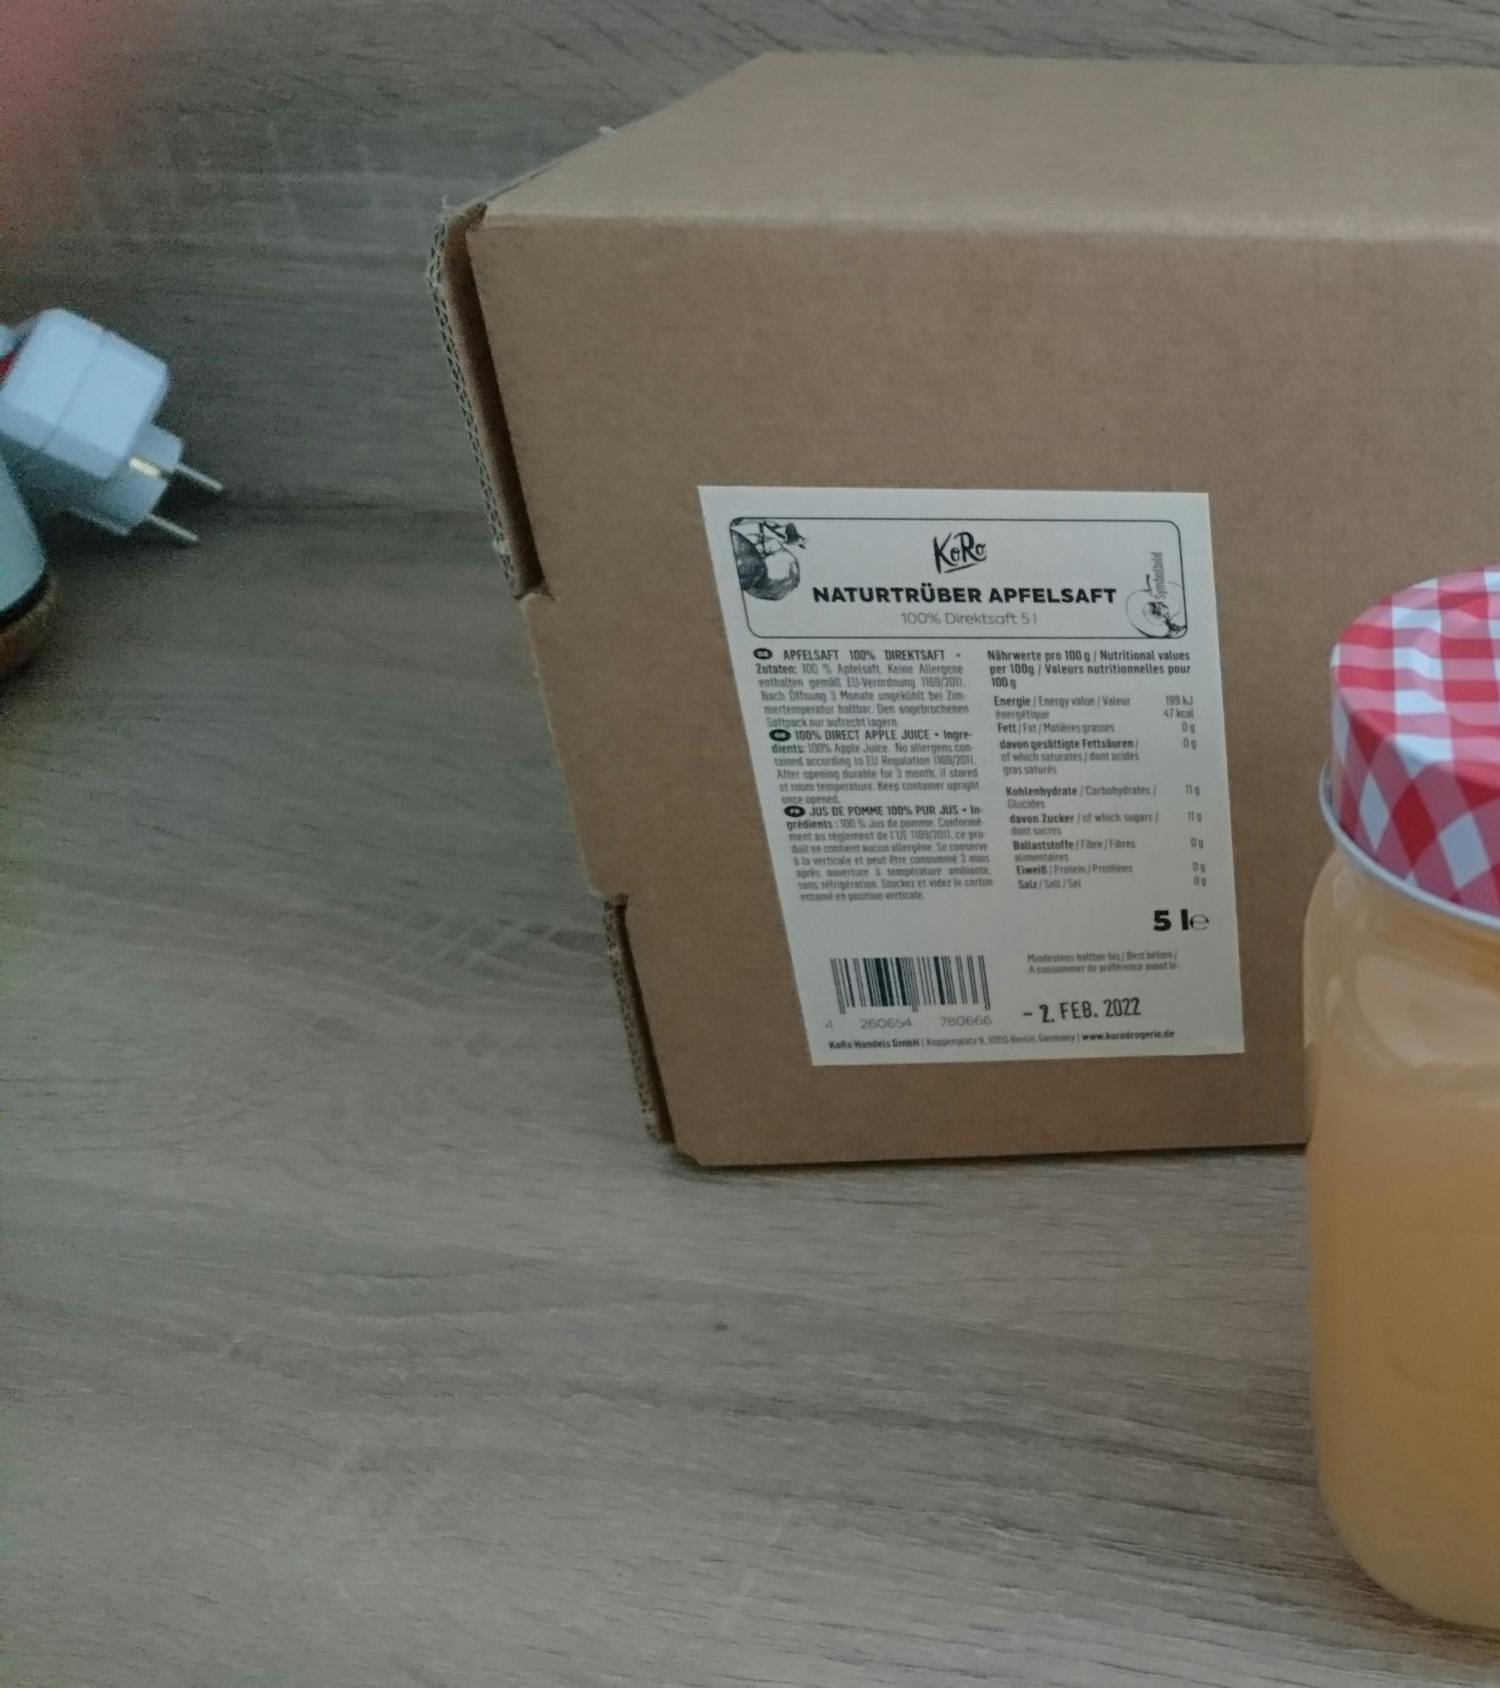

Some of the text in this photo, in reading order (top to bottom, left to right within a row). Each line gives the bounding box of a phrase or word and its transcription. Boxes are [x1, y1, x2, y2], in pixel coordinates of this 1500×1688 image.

[933, 531, 987, 573] KoRo
[812, 583, 1116, 603] NATURTRÜBER APFELSAFT
[901, 612, 941, 624] 100%
[945, 612, 1018, 624] Direktsaft
[1021, 613, 1030, 624] 5
[783, 650, 838, 660] APFELSAFT
[851, 650, 875, 660] 100%
[886, 650, 945, 660] DIREKTSAFT
[988, 650, 1190, 662] Nährwerte pro 100 g Nutritional values
[756, 664, 797, 674] Zutaten:
[803, 664, 818, 674] 100
[919, 665, 963, 676] Allergene
[990, 664, 1190, 676] per 100g Valeurs nutritionnelles pour
[992, 678, 1016, 689] 100 g
[994, 696, 1031, 707] Energie
[998, 723, 1016, 733] Fett
[795, 730, 821, 740] 100%
[825, 730, 859, 740] DIRECT
[865, 730, 897, 740] APPLE
[902, 730, 930, 740] JUICE
[1000, 739, 1028, 749] davon
[1083, 739, 1134, 748] Fettsäuren
[1006, 786, 1078, 798] Kohlenhydrate
[810, 807, 829, 816] JUS
[833, 807, 844, 816] DE
[848, 806, 883, 816] POMME
[887, 806, 913, 815] 100%
[916, 806, 935, 815] PUR
[940, 805, 958, 815] JUS
[1010, 814, 1038, 823] davon
[1042, 814, 1074, 823] Zucker
[1013, 840, 1073, 850] Ballaststoffe
[1154, 910, 1171, 931] 5
[1059, 1000, 1098, 1020] FEB.
[1103, 997, 1141, 1017] 2022
[940, 1016, 992, 1026] 780666
[893, 1038, 919, 1047] GmbH
